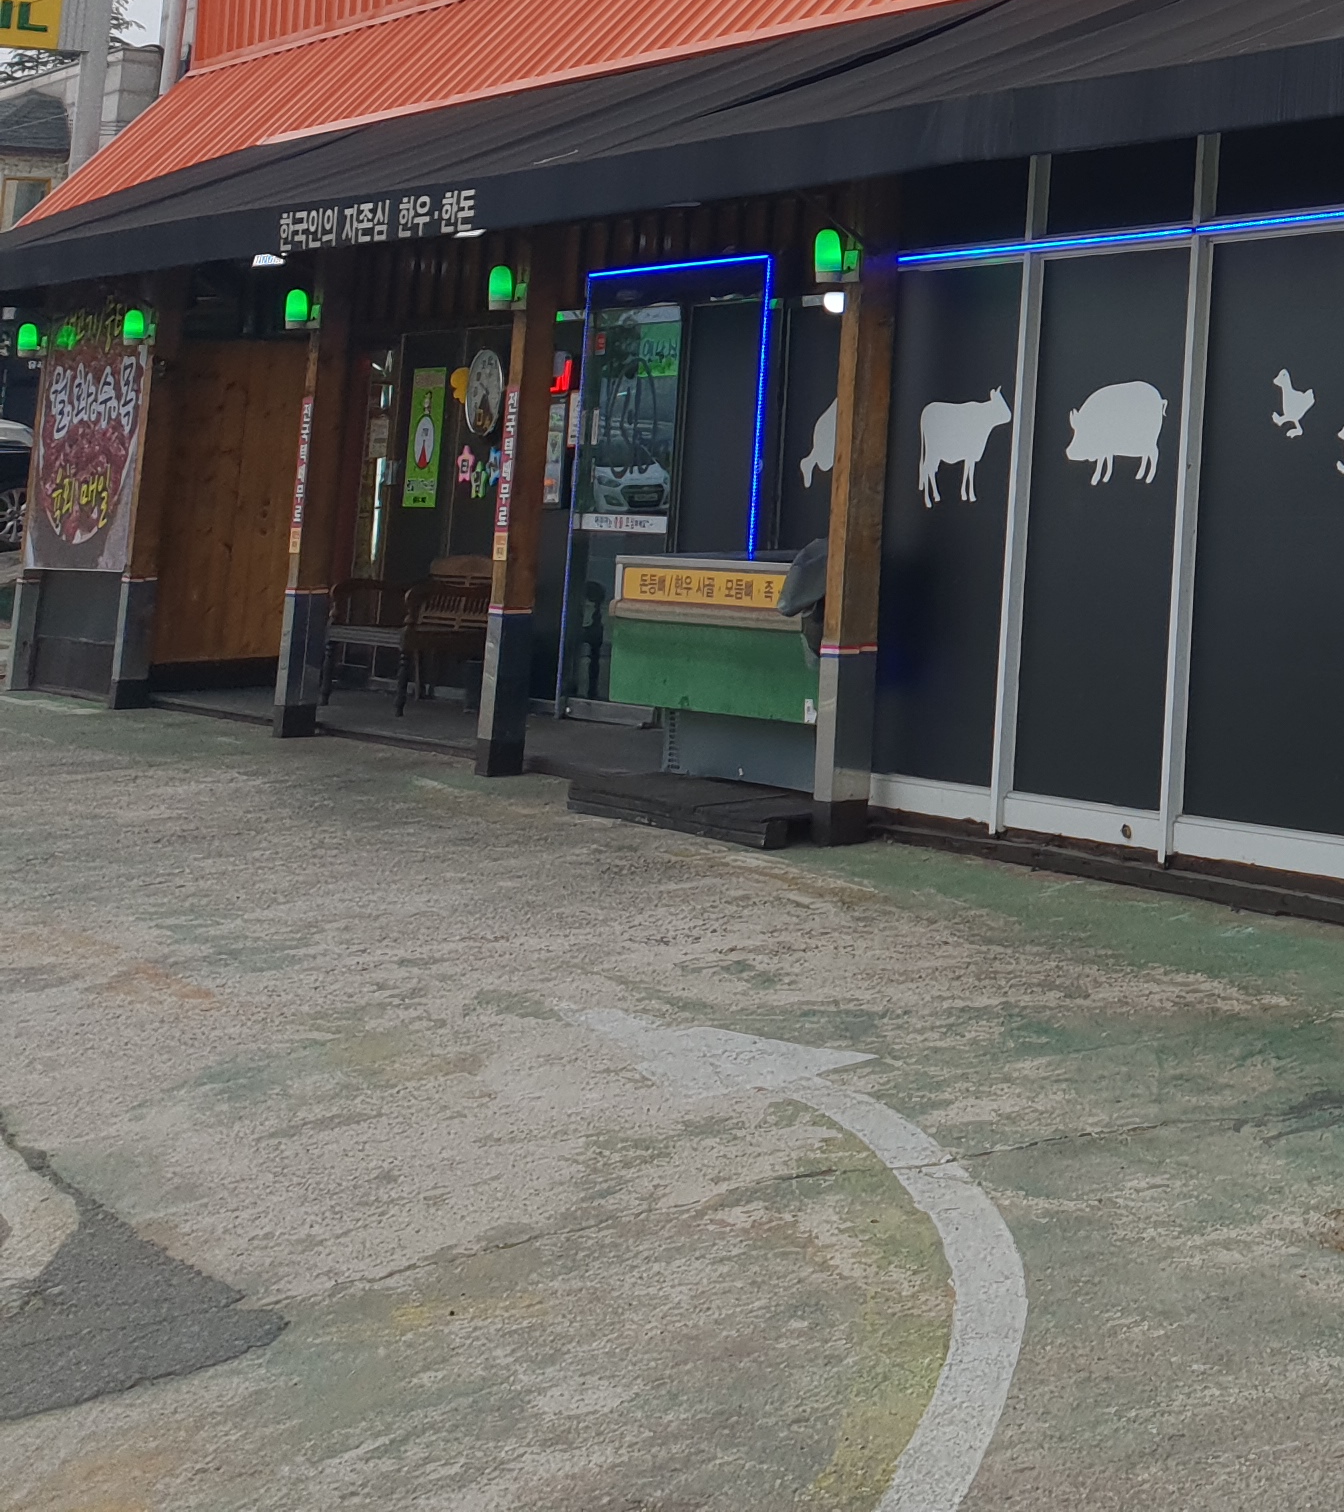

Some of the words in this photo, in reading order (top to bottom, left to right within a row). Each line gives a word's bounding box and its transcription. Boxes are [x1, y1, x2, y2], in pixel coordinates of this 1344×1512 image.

[279, 206, 339, 251] 한국인의
[342, 199, 391, 245] 자존심
[695, 576, 715, 598] 사골
